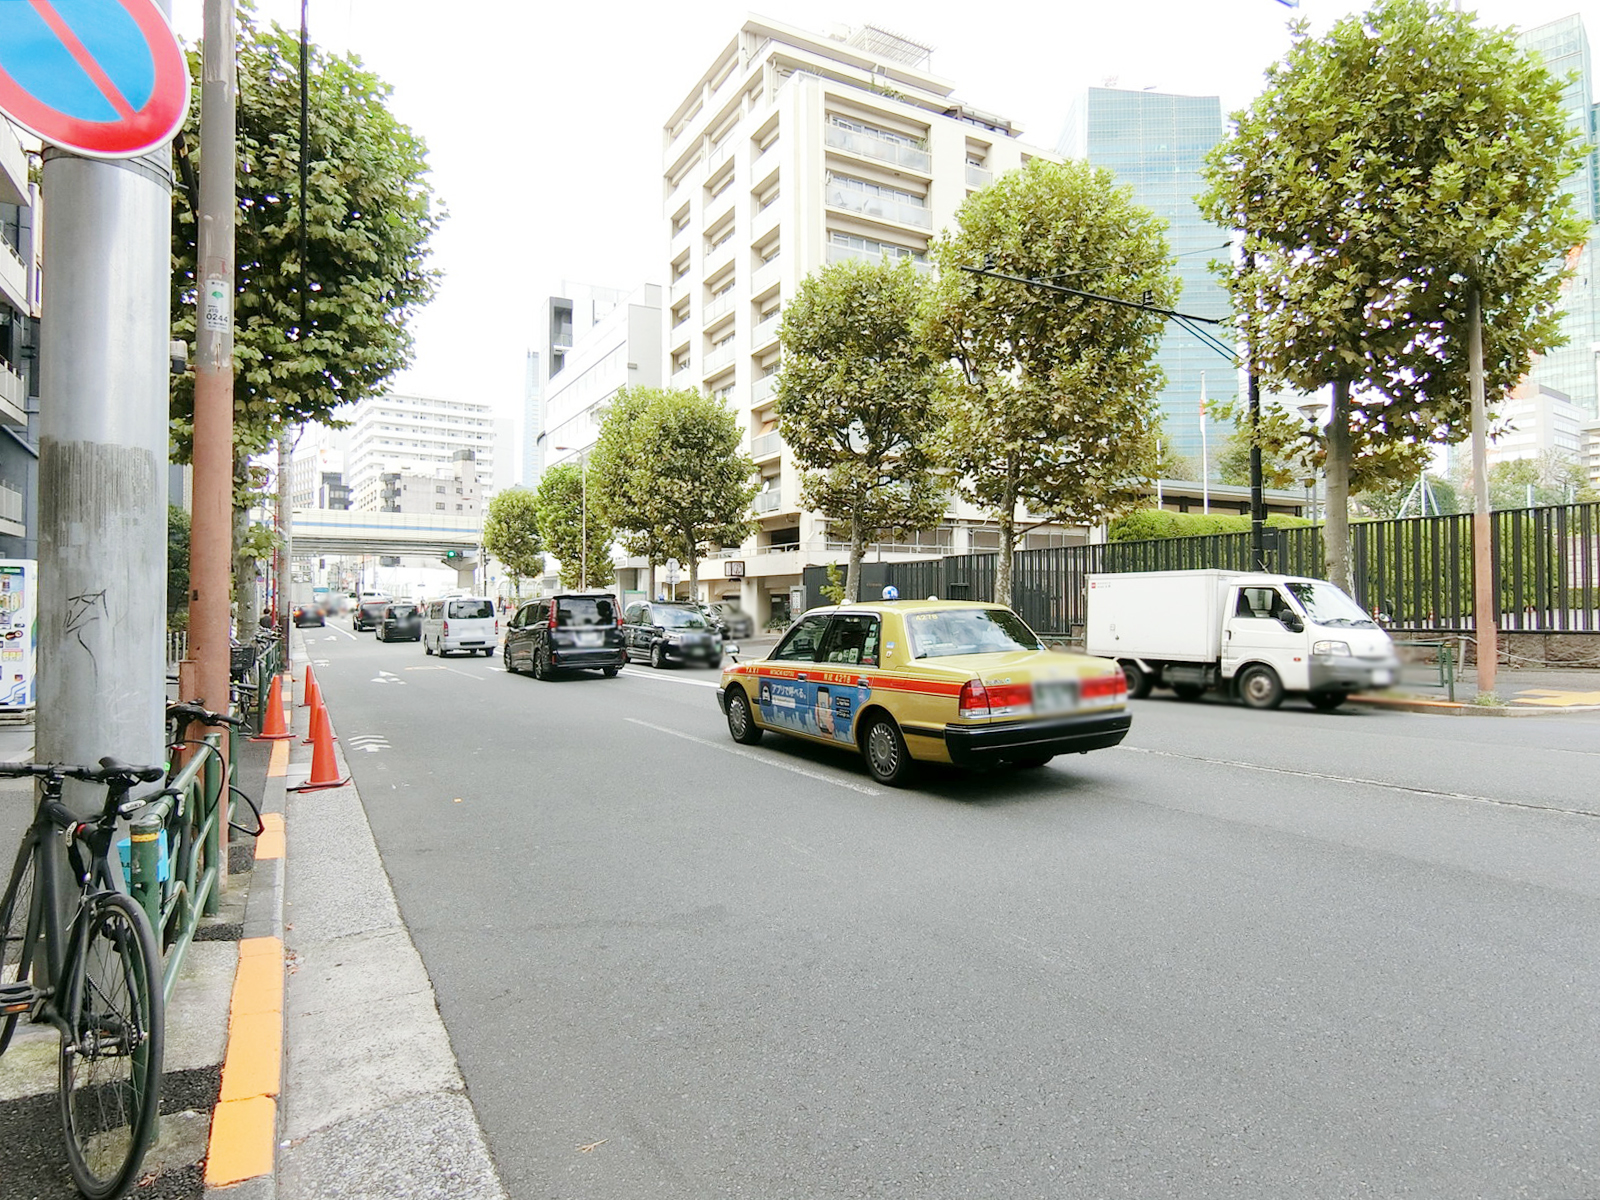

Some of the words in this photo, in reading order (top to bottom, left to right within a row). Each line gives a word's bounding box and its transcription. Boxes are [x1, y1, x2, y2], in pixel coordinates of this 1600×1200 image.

[206, 312, 228, 323] 0244
[746, 666, 759, 674] TAXI
[834, 674, 851, 683] 4278
